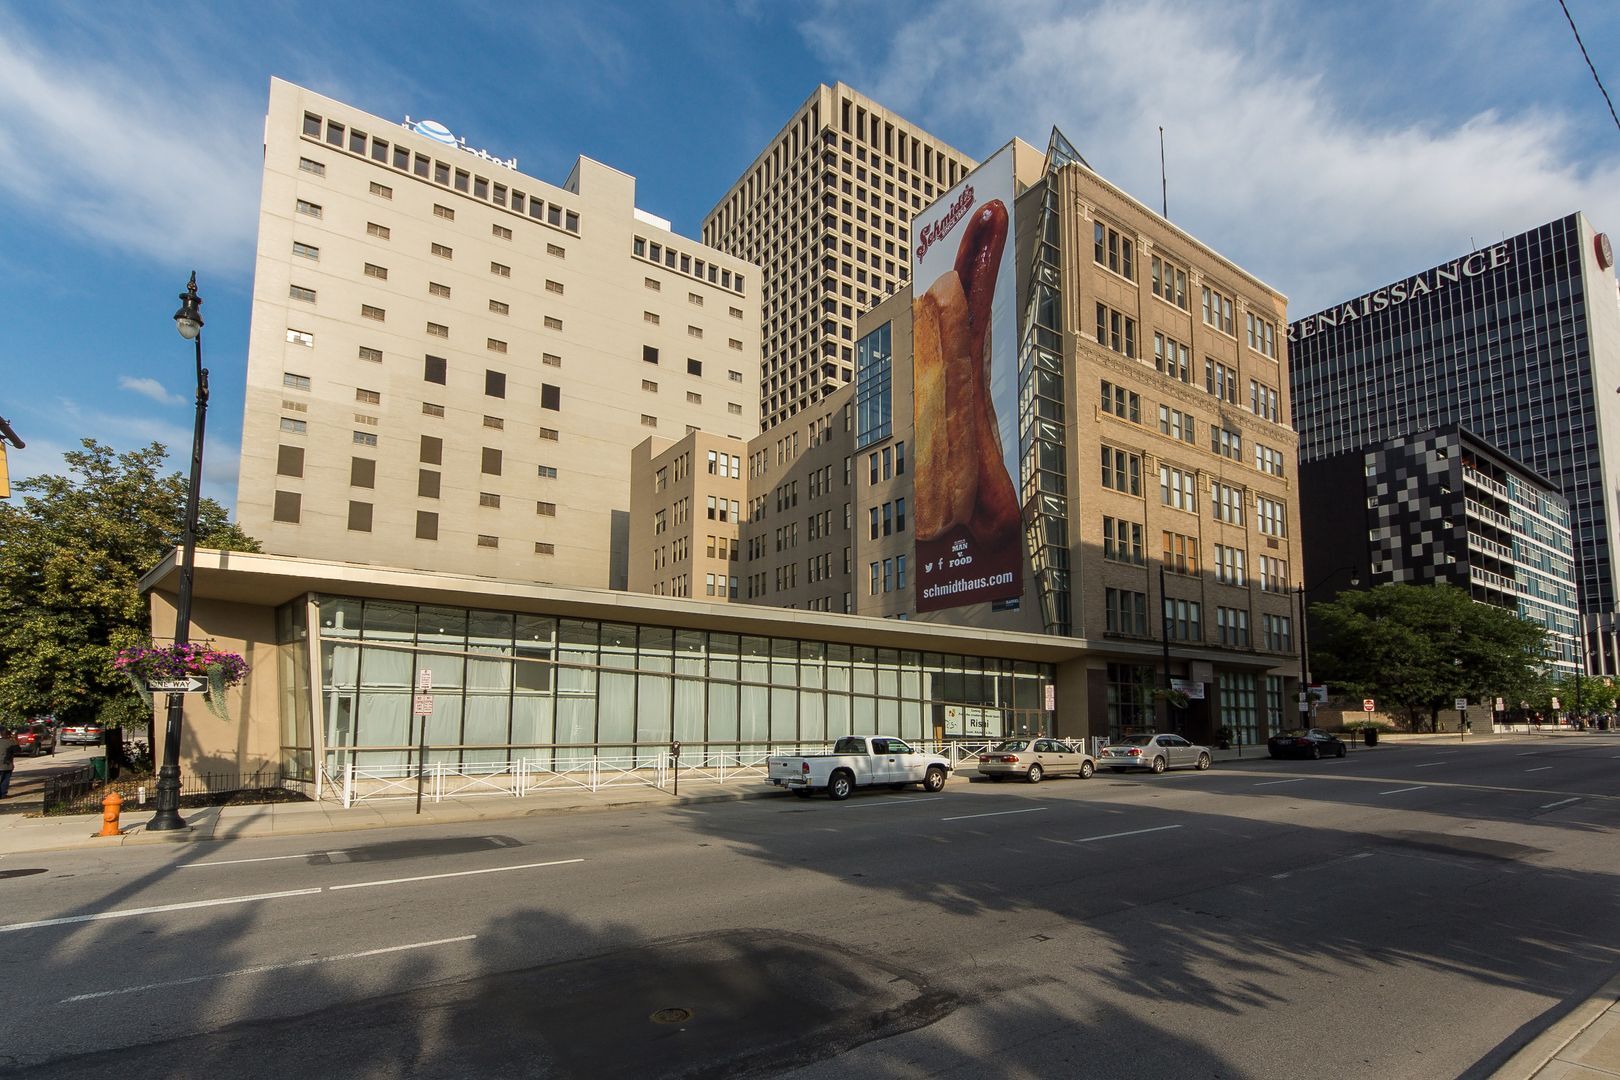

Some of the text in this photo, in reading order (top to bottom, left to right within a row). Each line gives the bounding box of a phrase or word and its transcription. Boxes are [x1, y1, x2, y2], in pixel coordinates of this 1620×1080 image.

[916, 184, 974, 264] Schmidt's
[1287, 243, 1510, 342] RENAISSANCE
[952, 542, 968, 552] MAN
[949, 556, 972, 567] FOOD
[923, 571, 1013, 598] schmidthaus.com
[173, 680, 191, 688] WAY
[970, 719, 989, 728] Risi
